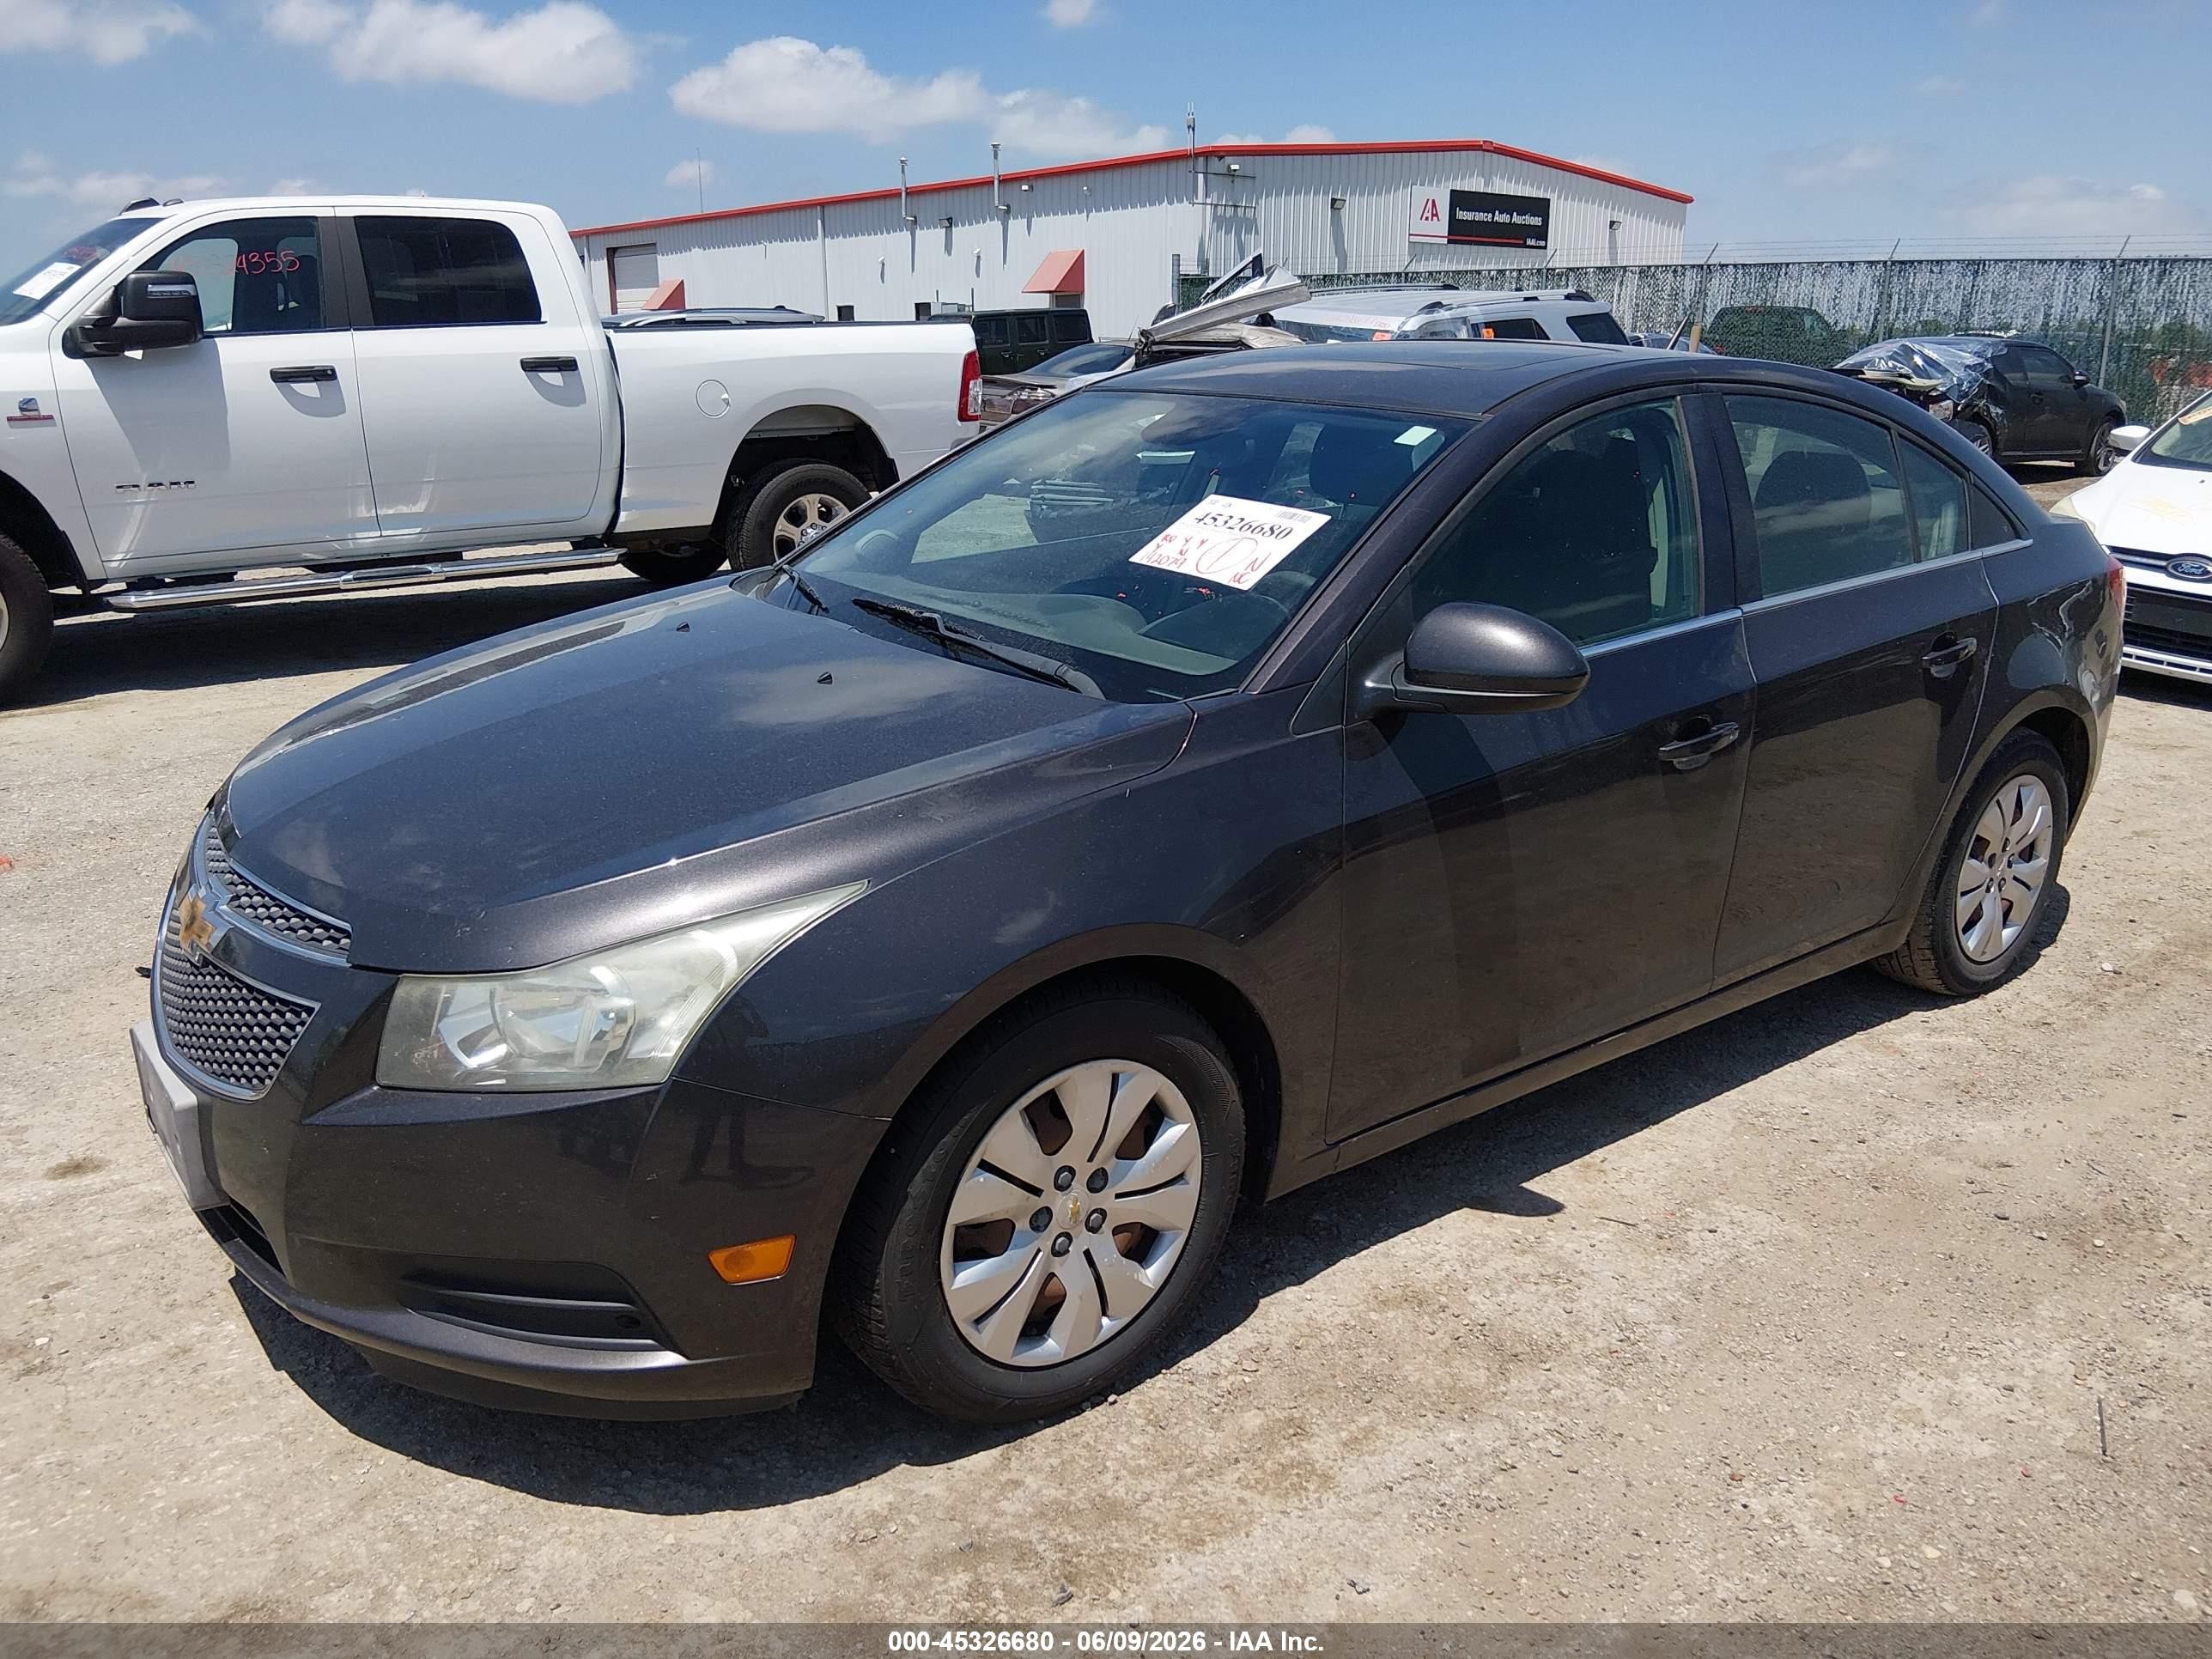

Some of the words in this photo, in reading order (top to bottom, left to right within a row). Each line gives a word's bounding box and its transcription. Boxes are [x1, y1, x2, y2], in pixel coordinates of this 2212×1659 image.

[1455, 206, 1492, 222] Insurance
[1493, 210, 1510, 223] Auto
[1511, 211, 1542, 226] Auctions
[1194, 511, 1294, 540] 45326680
[2177, 562, 2205, 574] Ford
